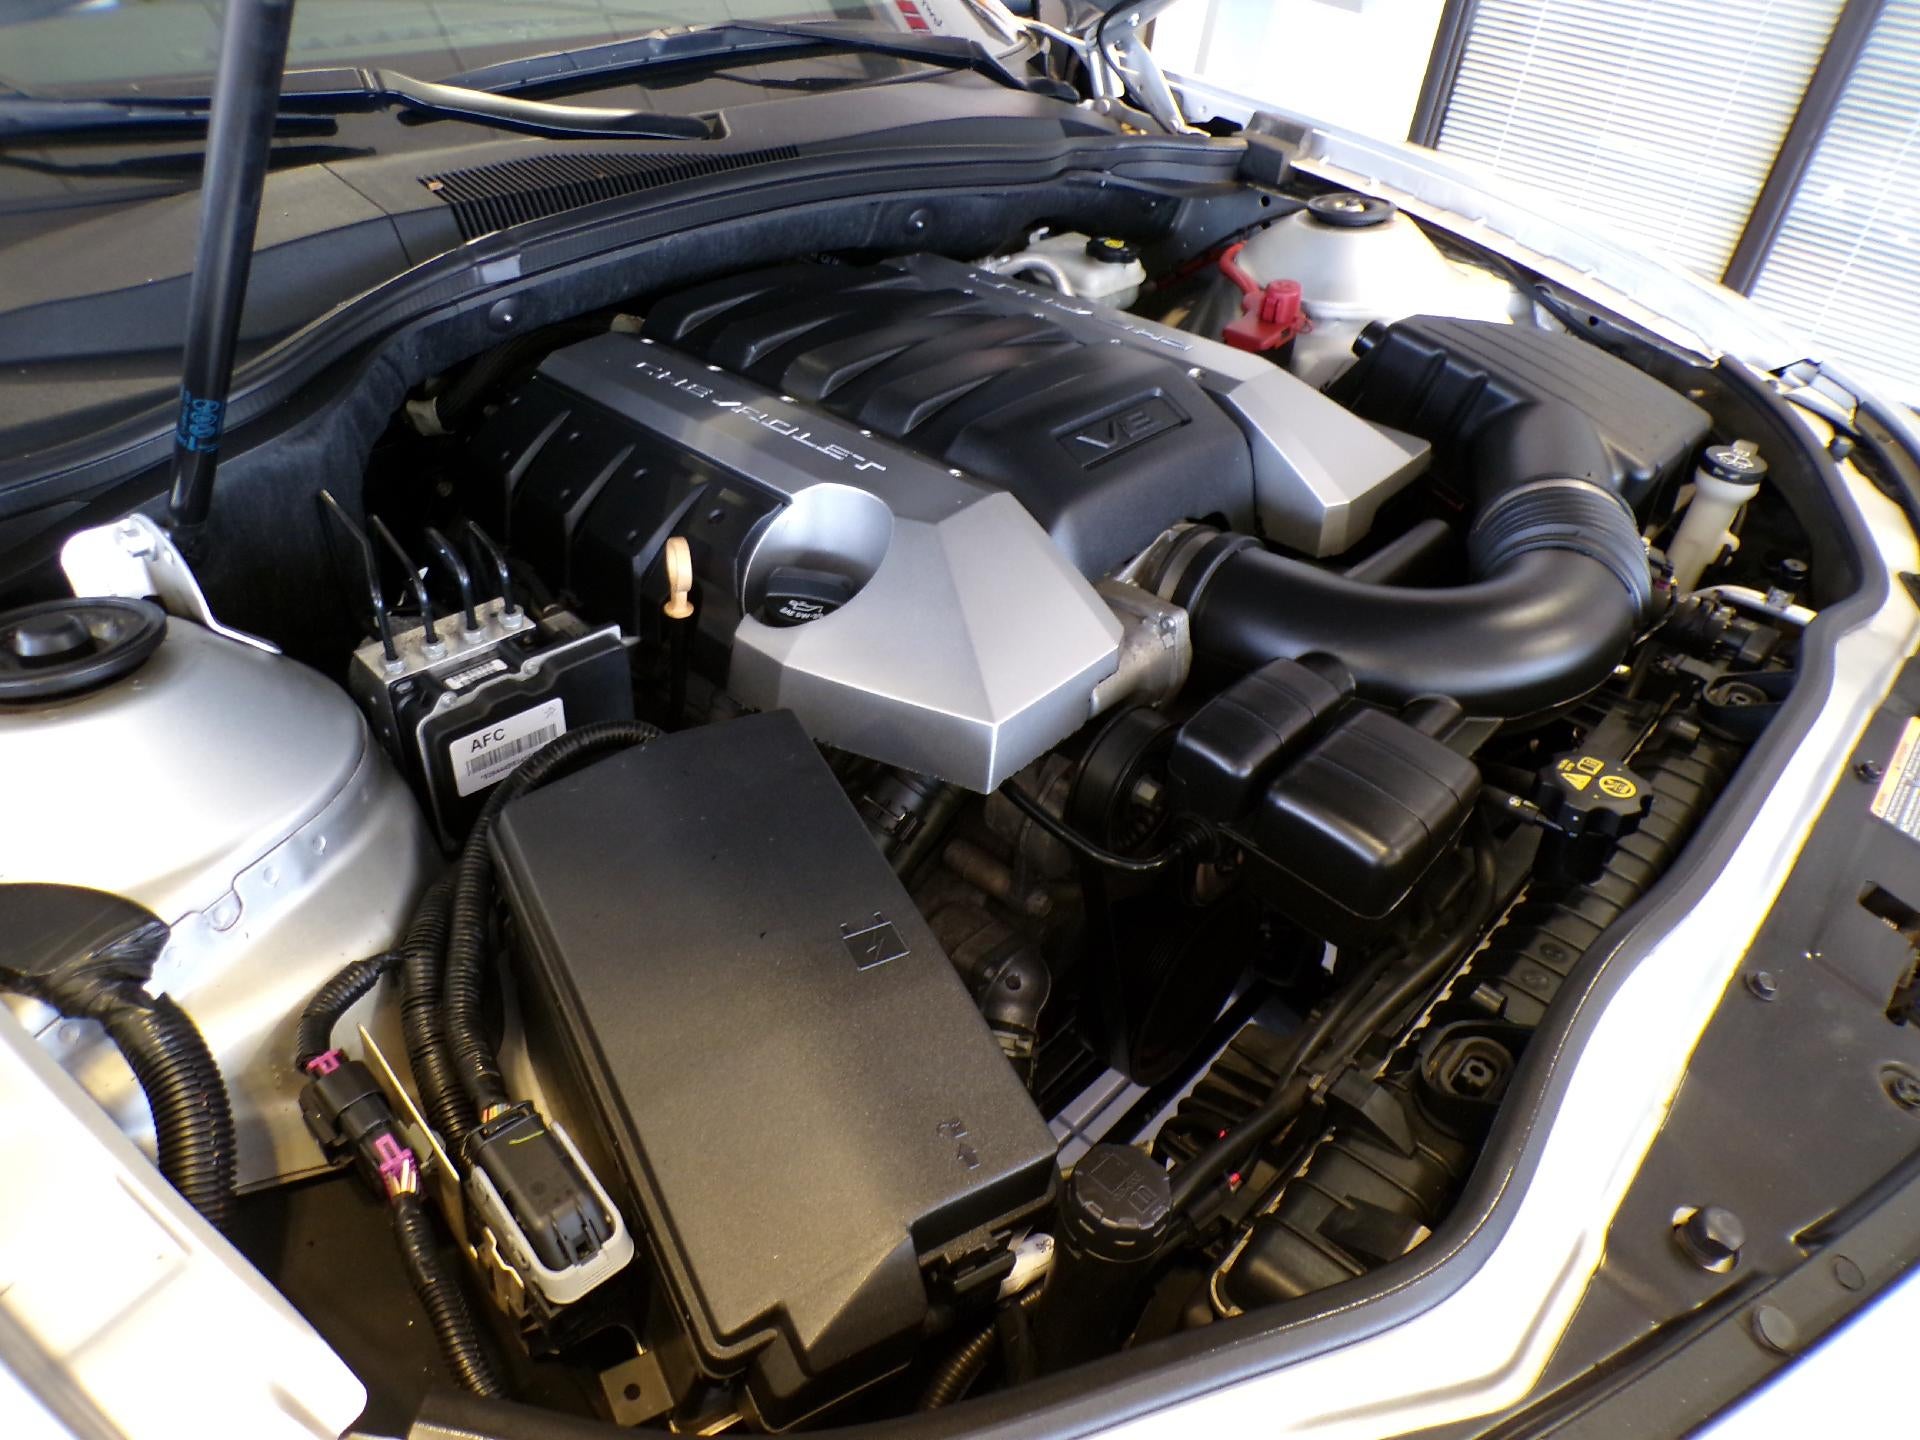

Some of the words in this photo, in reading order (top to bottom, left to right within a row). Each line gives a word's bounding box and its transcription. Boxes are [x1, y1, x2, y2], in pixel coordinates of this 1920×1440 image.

[635, 361, 888, 473] CHEVROLET
[1074, 410, 1163, 450] V8
[471, 728, 505, 753] AFC
